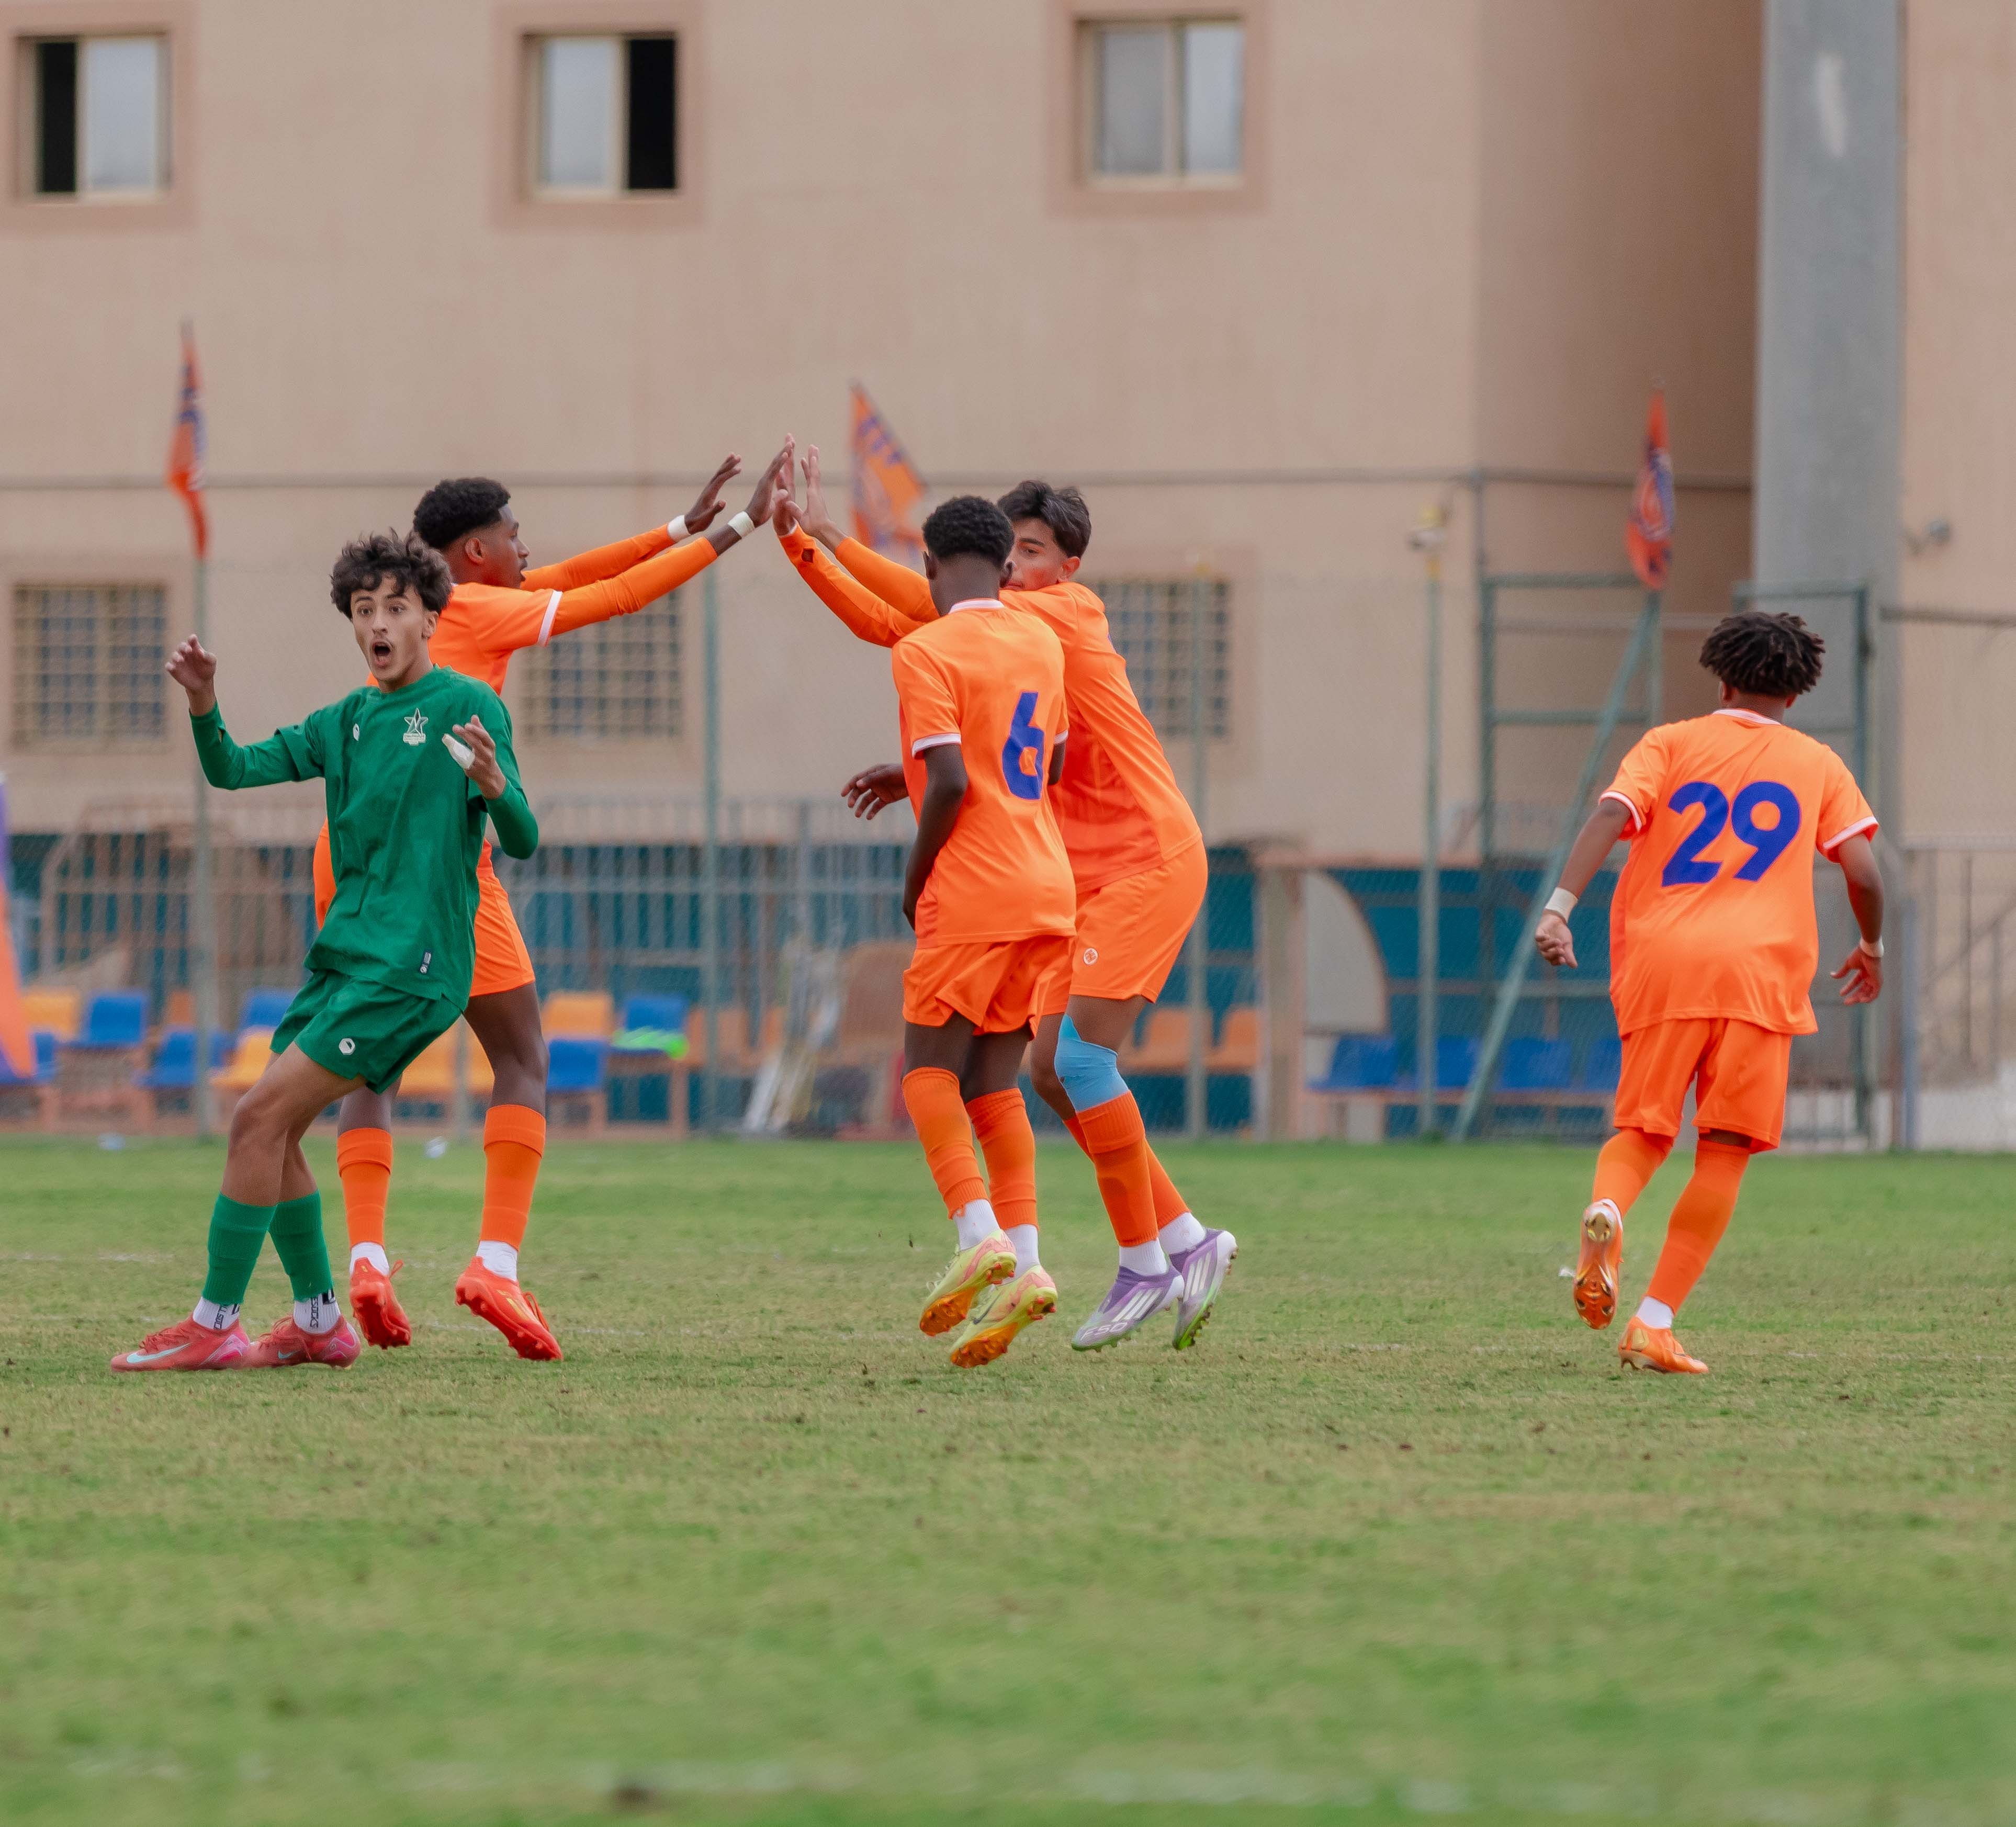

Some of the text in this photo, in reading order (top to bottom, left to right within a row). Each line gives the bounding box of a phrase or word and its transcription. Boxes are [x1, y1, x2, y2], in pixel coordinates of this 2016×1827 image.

[1001, 690, 1045, 801] 6
[1661, 780, 1803, 888] 29
[1079, 1322, 1128, 1342] F50
